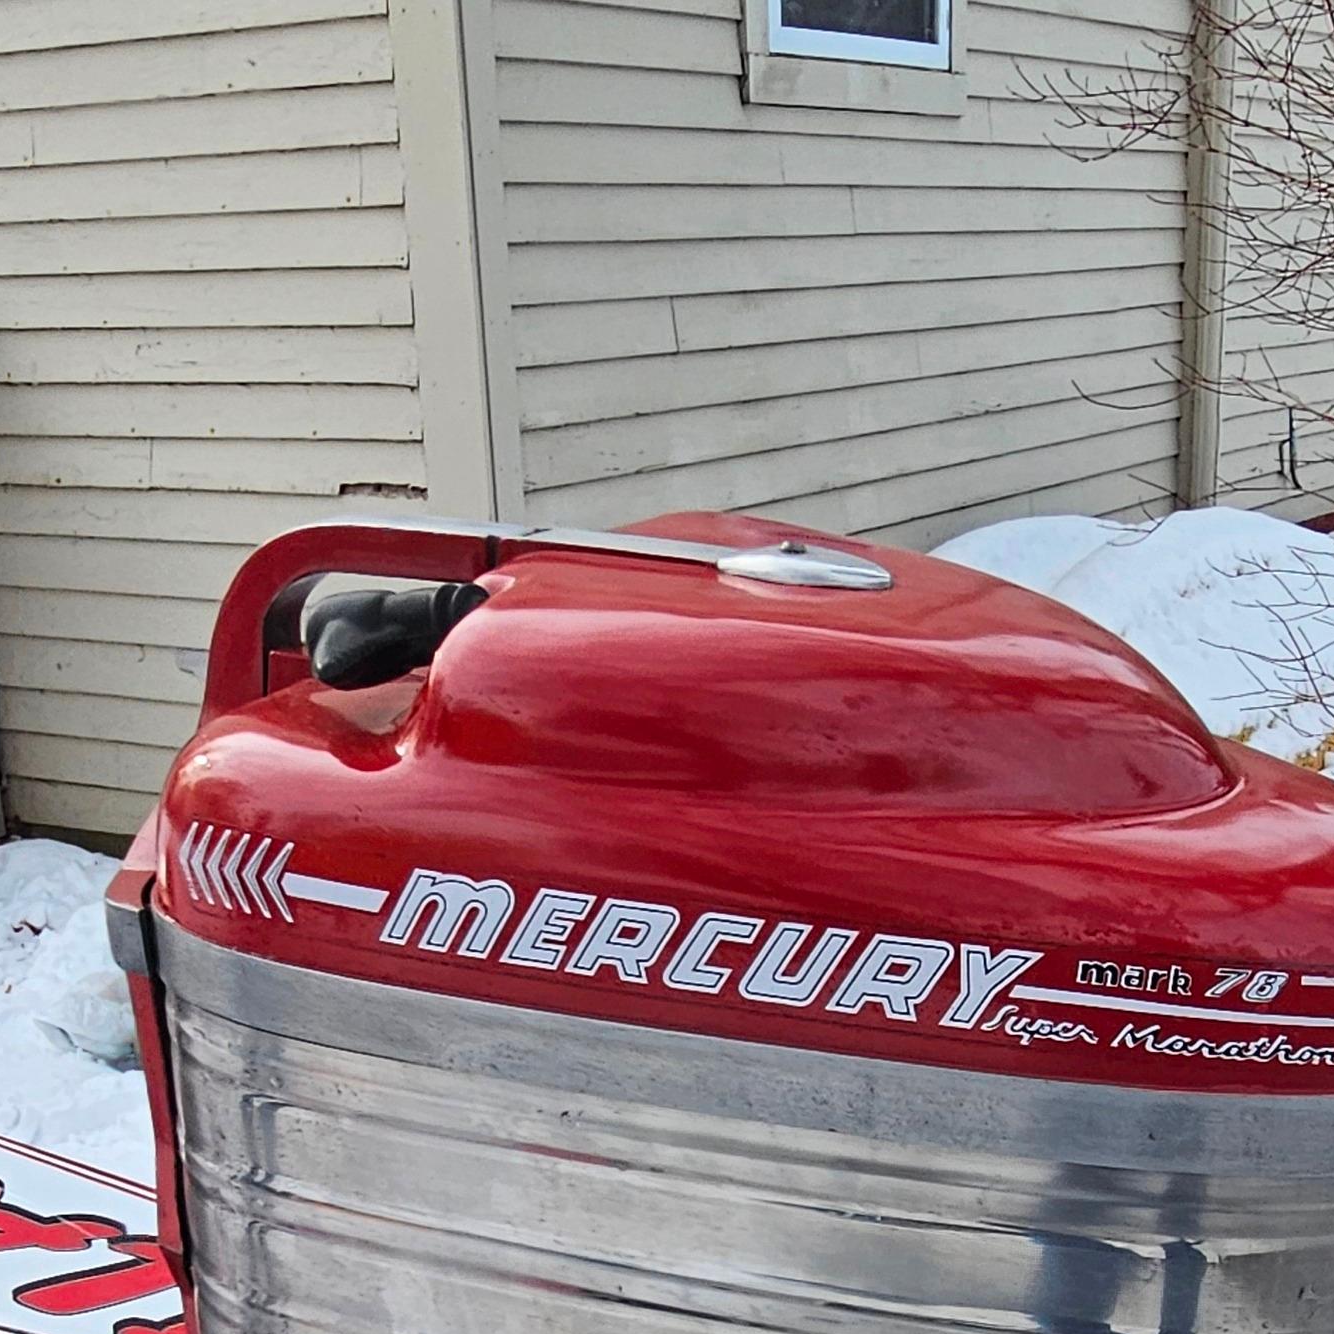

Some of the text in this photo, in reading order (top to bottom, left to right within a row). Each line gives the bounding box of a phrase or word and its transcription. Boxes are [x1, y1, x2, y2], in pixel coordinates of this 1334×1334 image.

[379, 867, 1045, 1031] MERCURY
[1075, 959, 1289, 1004] mark 78
[980, 1004, 1100, 1047] Super
